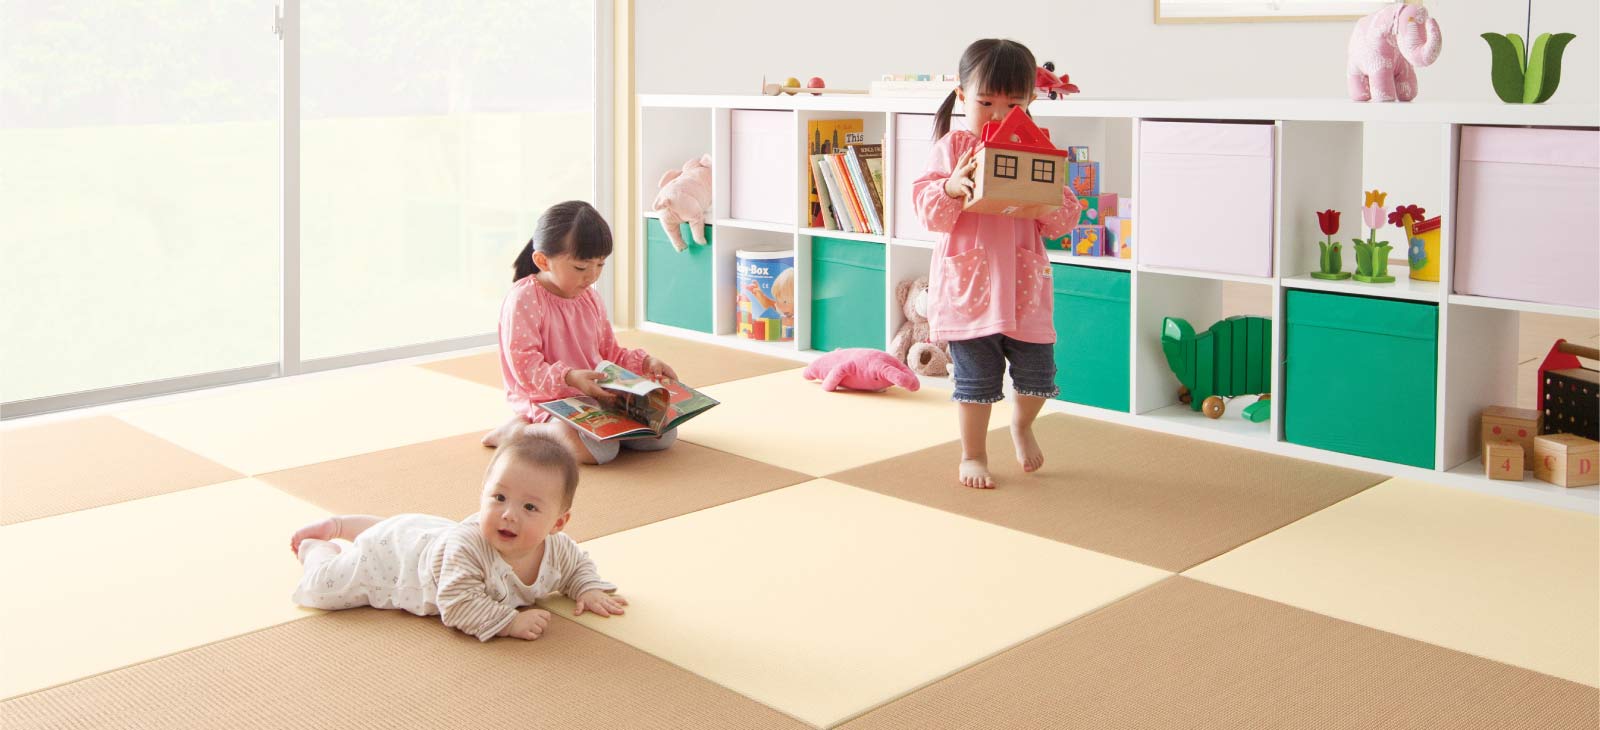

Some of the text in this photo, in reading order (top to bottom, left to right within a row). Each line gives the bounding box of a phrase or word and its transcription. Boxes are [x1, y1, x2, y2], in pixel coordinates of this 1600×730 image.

[846, 133, 864, 143] This
[1501, 458, 1511, 471] 4
[1543, 455, 1557, 471] C
[1579, 458, 1591, 474] D
